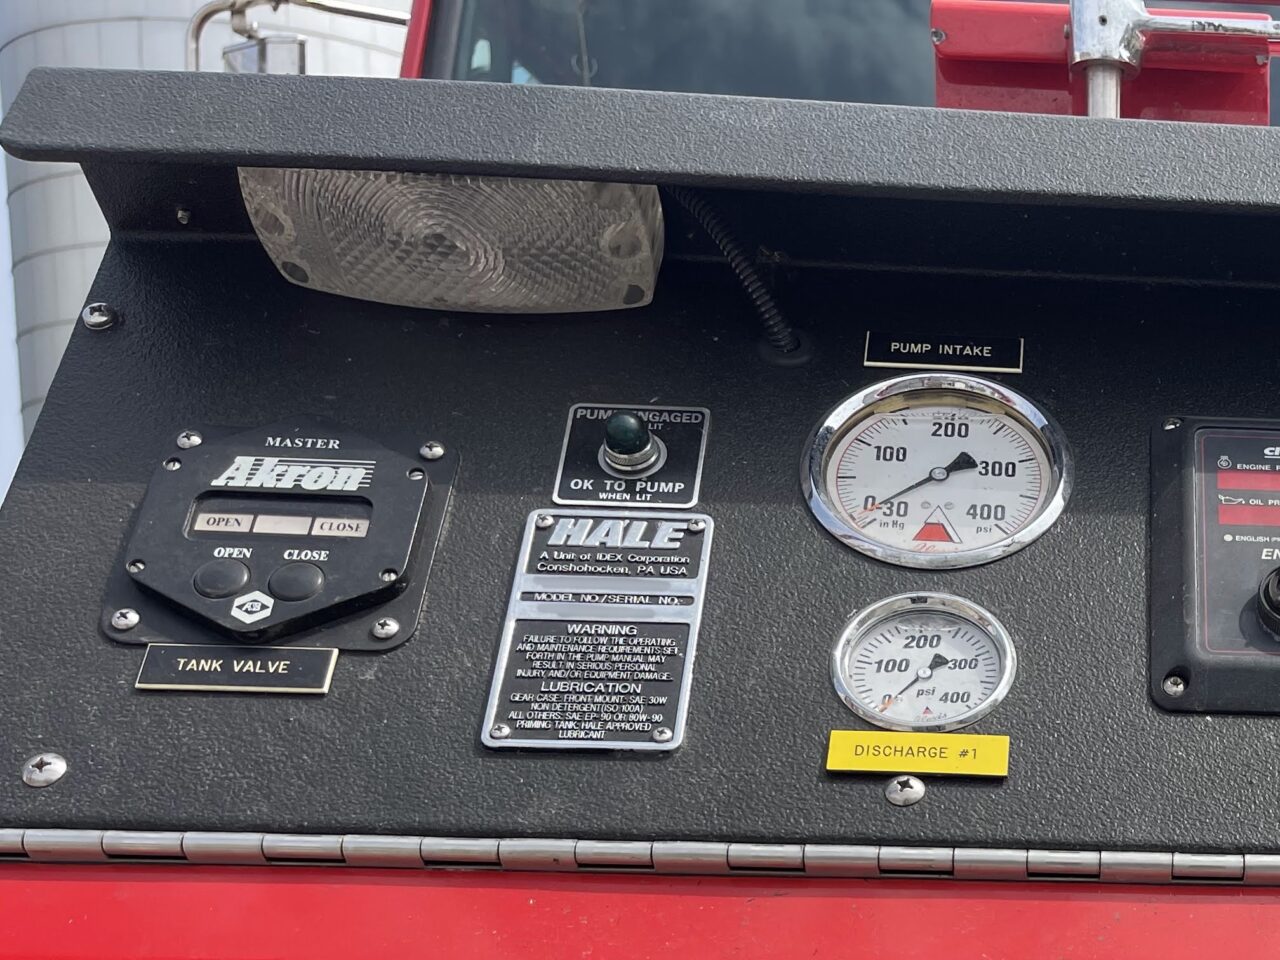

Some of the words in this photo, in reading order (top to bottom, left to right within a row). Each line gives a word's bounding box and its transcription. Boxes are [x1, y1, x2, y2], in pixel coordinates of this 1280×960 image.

[890, 342, 932, 354] PUMP
[939, 344, 992, 357] INTAKE
[576, 408, 616, 420] PUM
[930, 422, 969, 438] 200
[265, 436, 340, 449] MASTER
[873, 446, 907, 462] 100
[210, 456, 372, 491] Akron
[978, 460, 1016, 478] 300
[1237, 463, 1271, 471] ENGINE
[570, 479, 594, 490] OK
[604, 480, 626, 491] TO
[635, 481, 685, 493] PUMP
[599, 492, 631, 501] WHEN
[636, 493, 653, 501] LIT
[966, 504, 1006, 521] 400
[206, 516, 243, 528] OPEN
[320, 521, 363, 533] CLOSE
[547, 518, 688, 549] HALE
[213, 547, 252, 559] OPEN
[283, 549, 329, 561] CLOSE
[596, 552, 622, 561] IDEX
[627, 553, 690, 564] Corporation
[537, 561, 631, 574] Conshohocken,
[637, 564, 655, 574] PA
[660, 565, 688, 575] USA
[567, 623, 638, 635] WARNING
[523, 635, 557, 643] FAILURE
[573, 636, 608, 644] FOLLOW
[628, 637, 676, 646] OPERATING
[902, 634, 941, 649] 200
[586, 653, 609, 661] PUMP
[648, 655, 667, 663] MAY
[948, 657, 979, 670] 300
[176, 658, 223, 672] TANK
[233, 660, 291, 674] VALVE
[576, 662, 612, 670] SERIOUS
[874, 658, 910, 673] 100
[541, 681, 642, 694] LUBRICATION
[916, 686, 936, 698] psi
[649, 696, 668, 704] 30W
[939, 691, 971, 704] 400
[605, 722, 652, 731] APPROVED
[854, 744, 948, 759] DISCHARGE
[958, 748, 977, 760] #1
